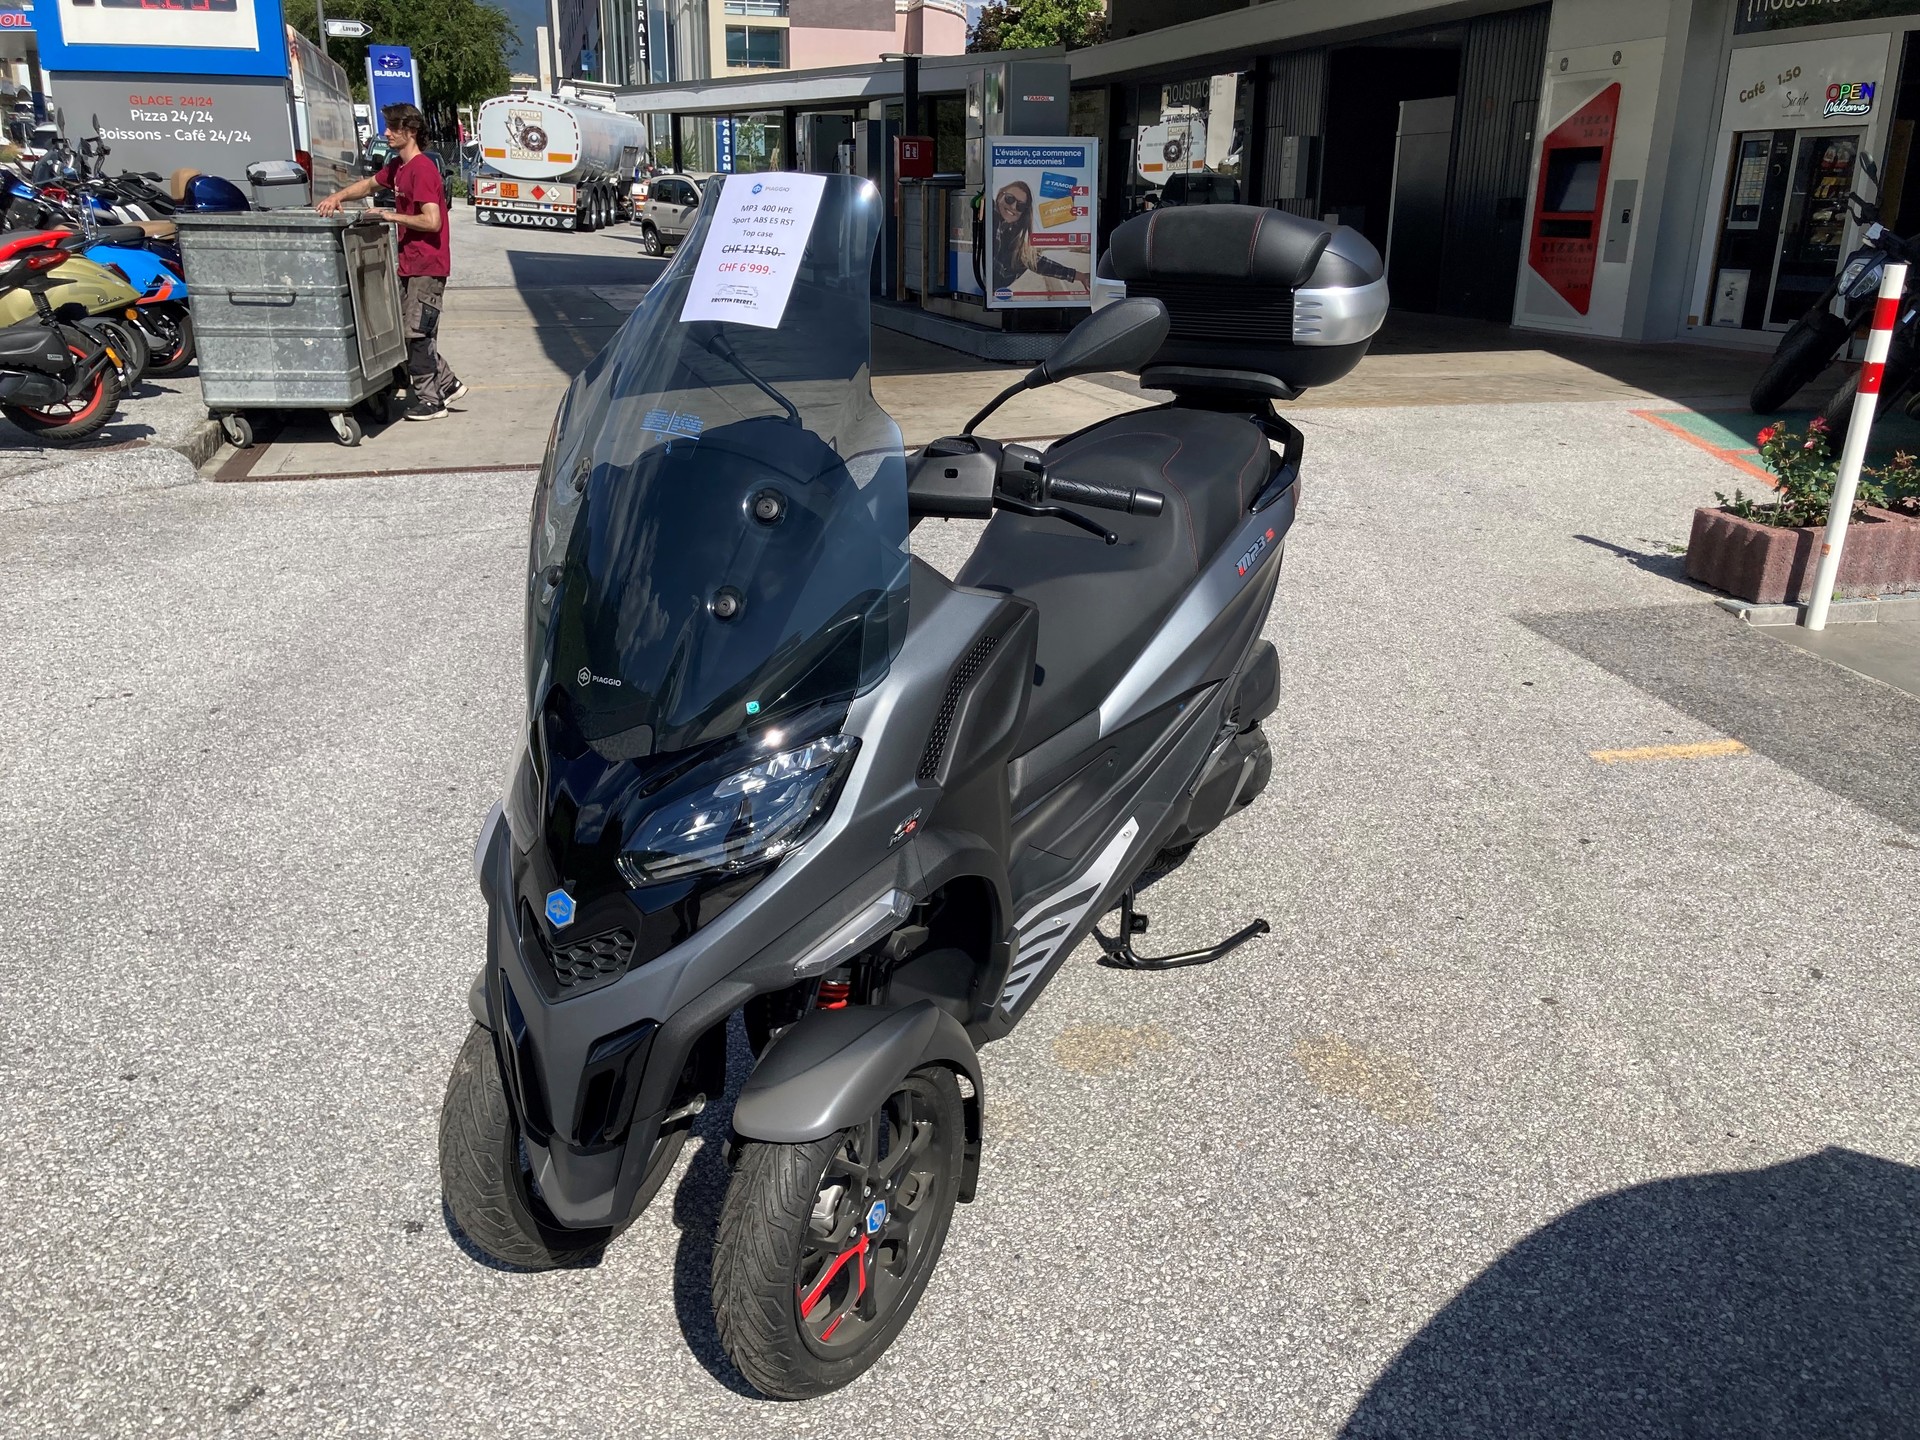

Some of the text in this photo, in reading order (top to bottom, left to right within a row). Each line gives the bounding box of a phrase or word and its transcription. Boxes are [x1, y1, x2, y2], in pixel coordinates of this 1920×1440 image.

[342, 25, 360, 33] Lavage
[374, 70, 411, 78] SUBARU
[1739, 66, 1802, 103] Café 1.50
[1826, 82, 1876, 101] OPEN
[129, 95, 174, 106] GLACE
[1824, 98, 1871, 118] Welcome
[130, 109, 214, 125] Pizza 24/24
[816, 115, 823, 124] 4
[98, 127, 161, 140] Boissons
[174, 128, 206, 141] Café
[209, 130, 252, 145] 24/24
[995, 149, 1031, 158] L'évasion,
[1032, 150, 1041, 158] ça
[995, 158, 1008, 166] par
[1009, 157, 1022, 165] des
[741, 204, 793, 214] MP3 400 HPE
[495, 211, 558, 228] VOLVO
[732, 216, 795, 226] Sport ABS E5 RST
[742, 229, 756, 238] Top
[722, 244, 742, 254] CHF
[718, 262, 776, 275] CHF 6'999.-
[592, 675, 622, 687] PIAGGIO
